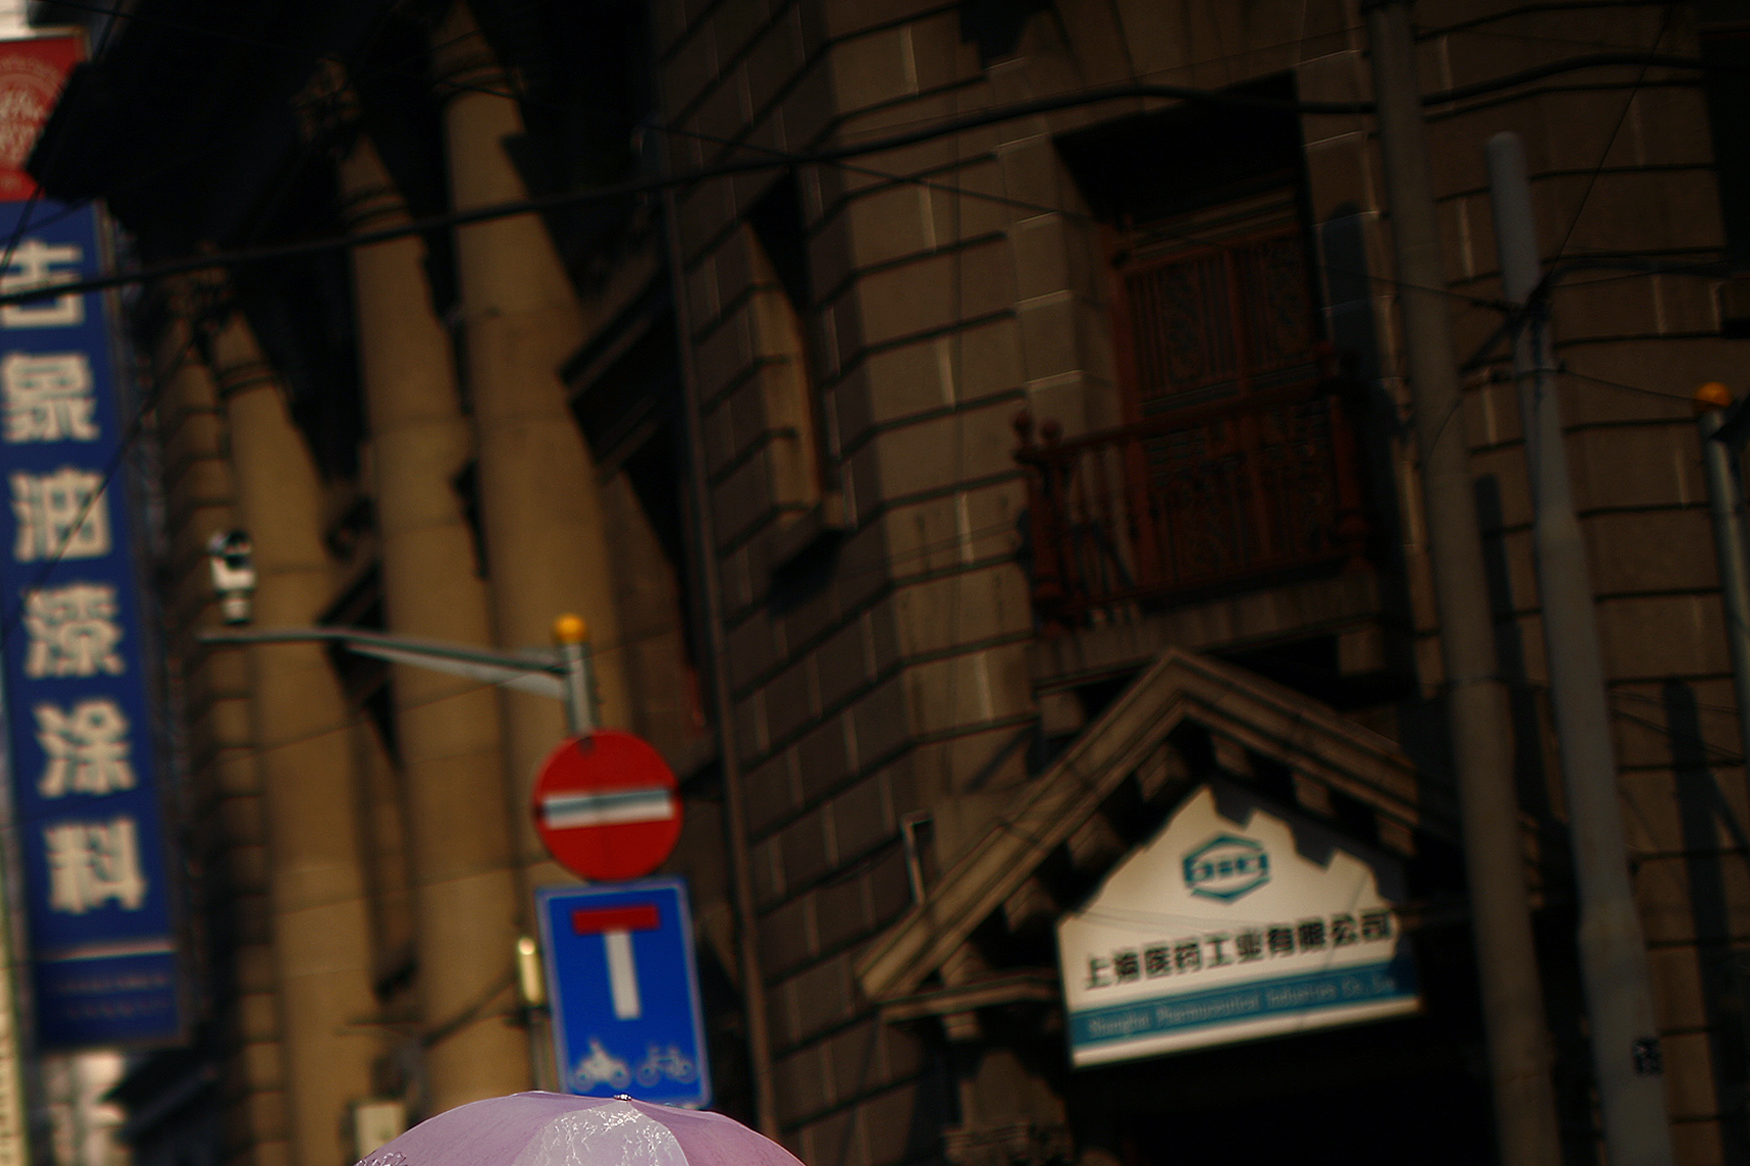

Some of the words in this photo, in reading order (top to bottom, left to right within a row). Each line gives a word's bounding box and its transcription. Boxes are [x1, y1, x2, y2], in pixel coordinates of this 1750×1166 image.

[1086, 911, 1392, 988] 上海医药工业有限公司
